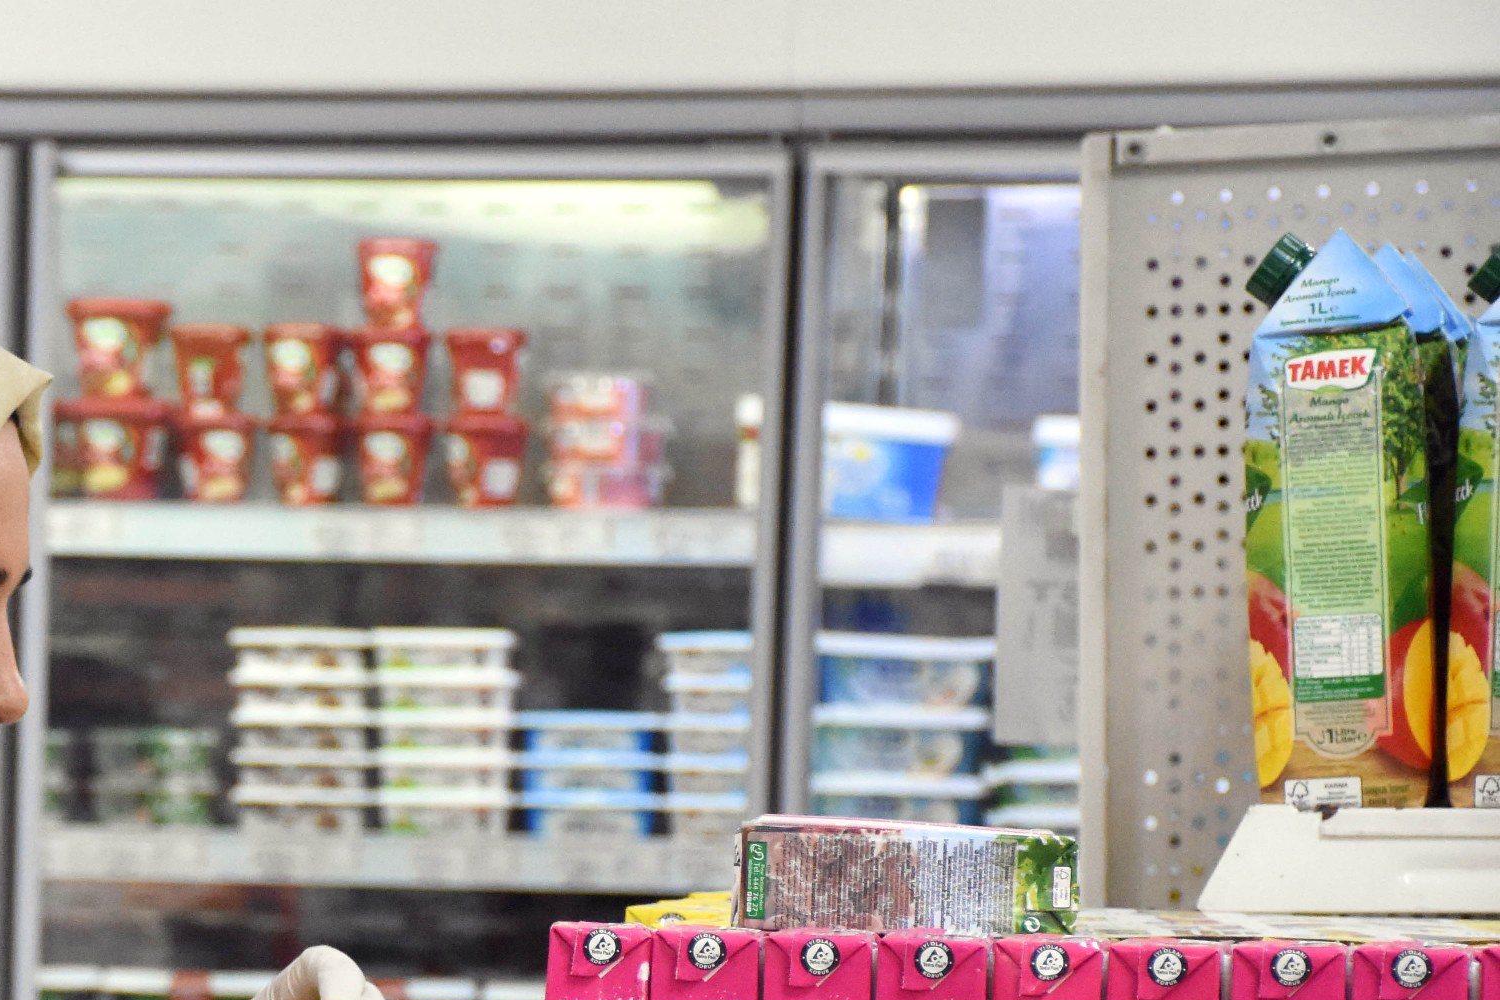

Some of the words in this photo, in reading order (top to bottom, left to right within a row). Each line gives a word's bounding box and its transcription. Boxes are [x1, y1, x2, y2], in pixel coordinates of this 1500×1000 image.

[1287, 356, 1367, 382] TAMEK
[703, 933, 722, 943] OLANI
[817, 938, 835, 949] OLANI
[1164, 948, 1183, 959] OLANI
